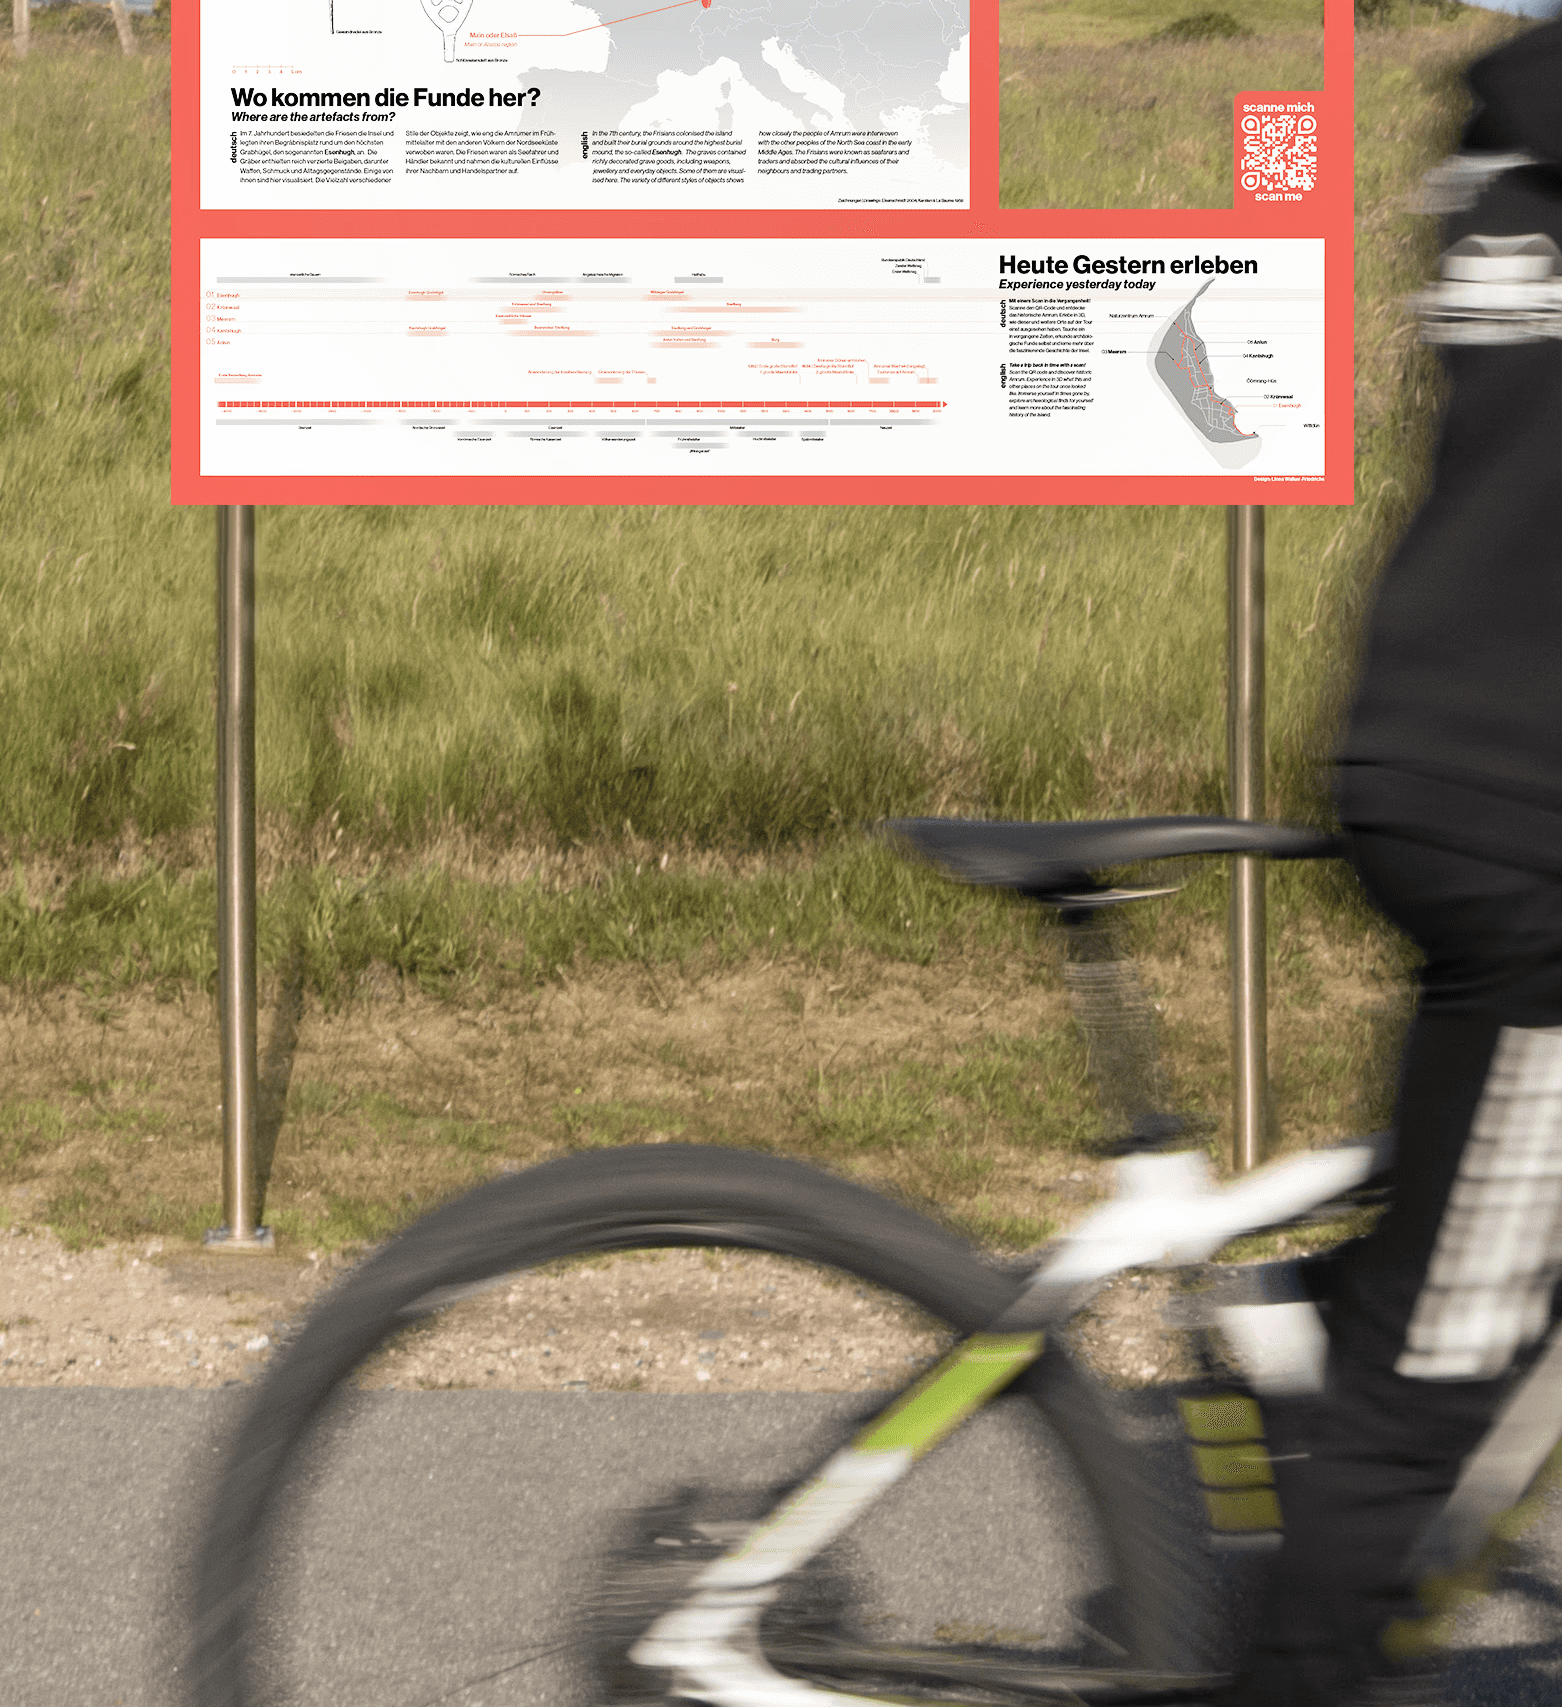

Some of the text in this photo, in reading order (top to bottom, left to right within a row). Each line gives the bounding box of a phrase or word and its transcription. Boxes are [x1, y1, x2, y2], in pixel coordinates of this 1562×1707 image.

[230, 87, 541, 107] Wo kommen die Funde her?
[1243, 102, 1315, 112] scanne mich
[230, 112, 269, 121] Where
[289, 112, 309, 121] the
[309, 112, 361, 121] artefacts
[361, 112, 396, 121] from?
[581, 131, 589, 159] english
[1255, 193, 1303, 201] scan me
[999, 255, 1258, 274] Heute Gestern erleben
[998, 279, 1157, 291] Experience yesterday today
